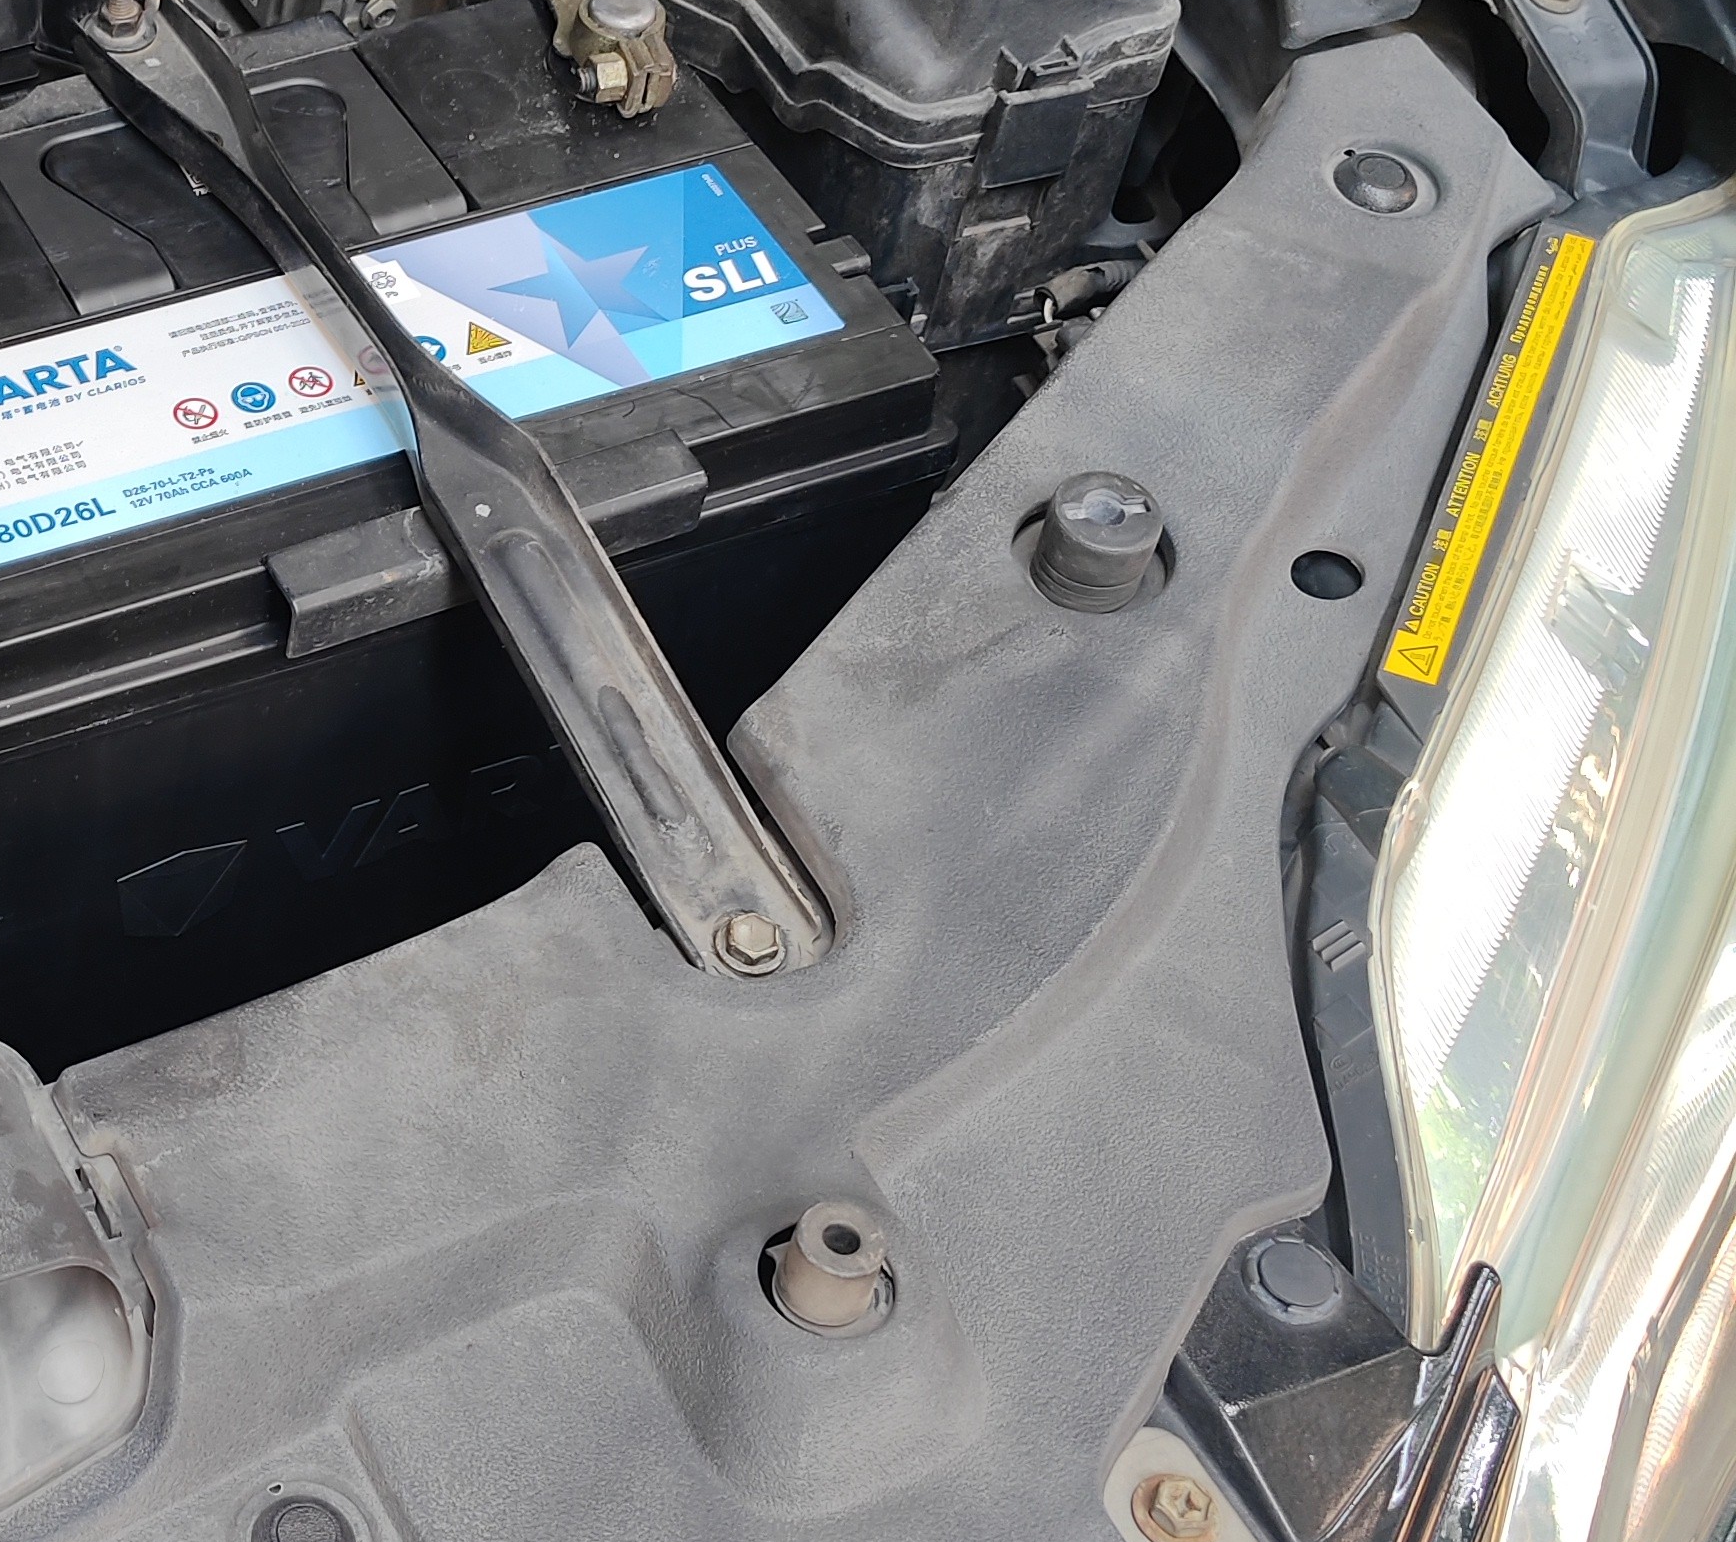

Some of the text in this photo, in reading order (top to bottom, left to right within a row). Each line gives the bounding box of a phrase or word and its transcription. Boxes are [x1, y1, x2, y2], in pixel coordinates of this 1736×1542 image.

[713, 235, 758, 256] PLUS
[683, 250, 777, 301] SLI
[63, 391, 82, 403] BY
[86, 375, 146, 397] CLARIOS
[1485, 353, 1516, 408] ACHTUNG
[128, 467, 253, 509] 12V 70Ah CCA 600A
[1444, 450, 1480, 517] ATTENTION
[1408, 561, 1440, 616] CAUTION
